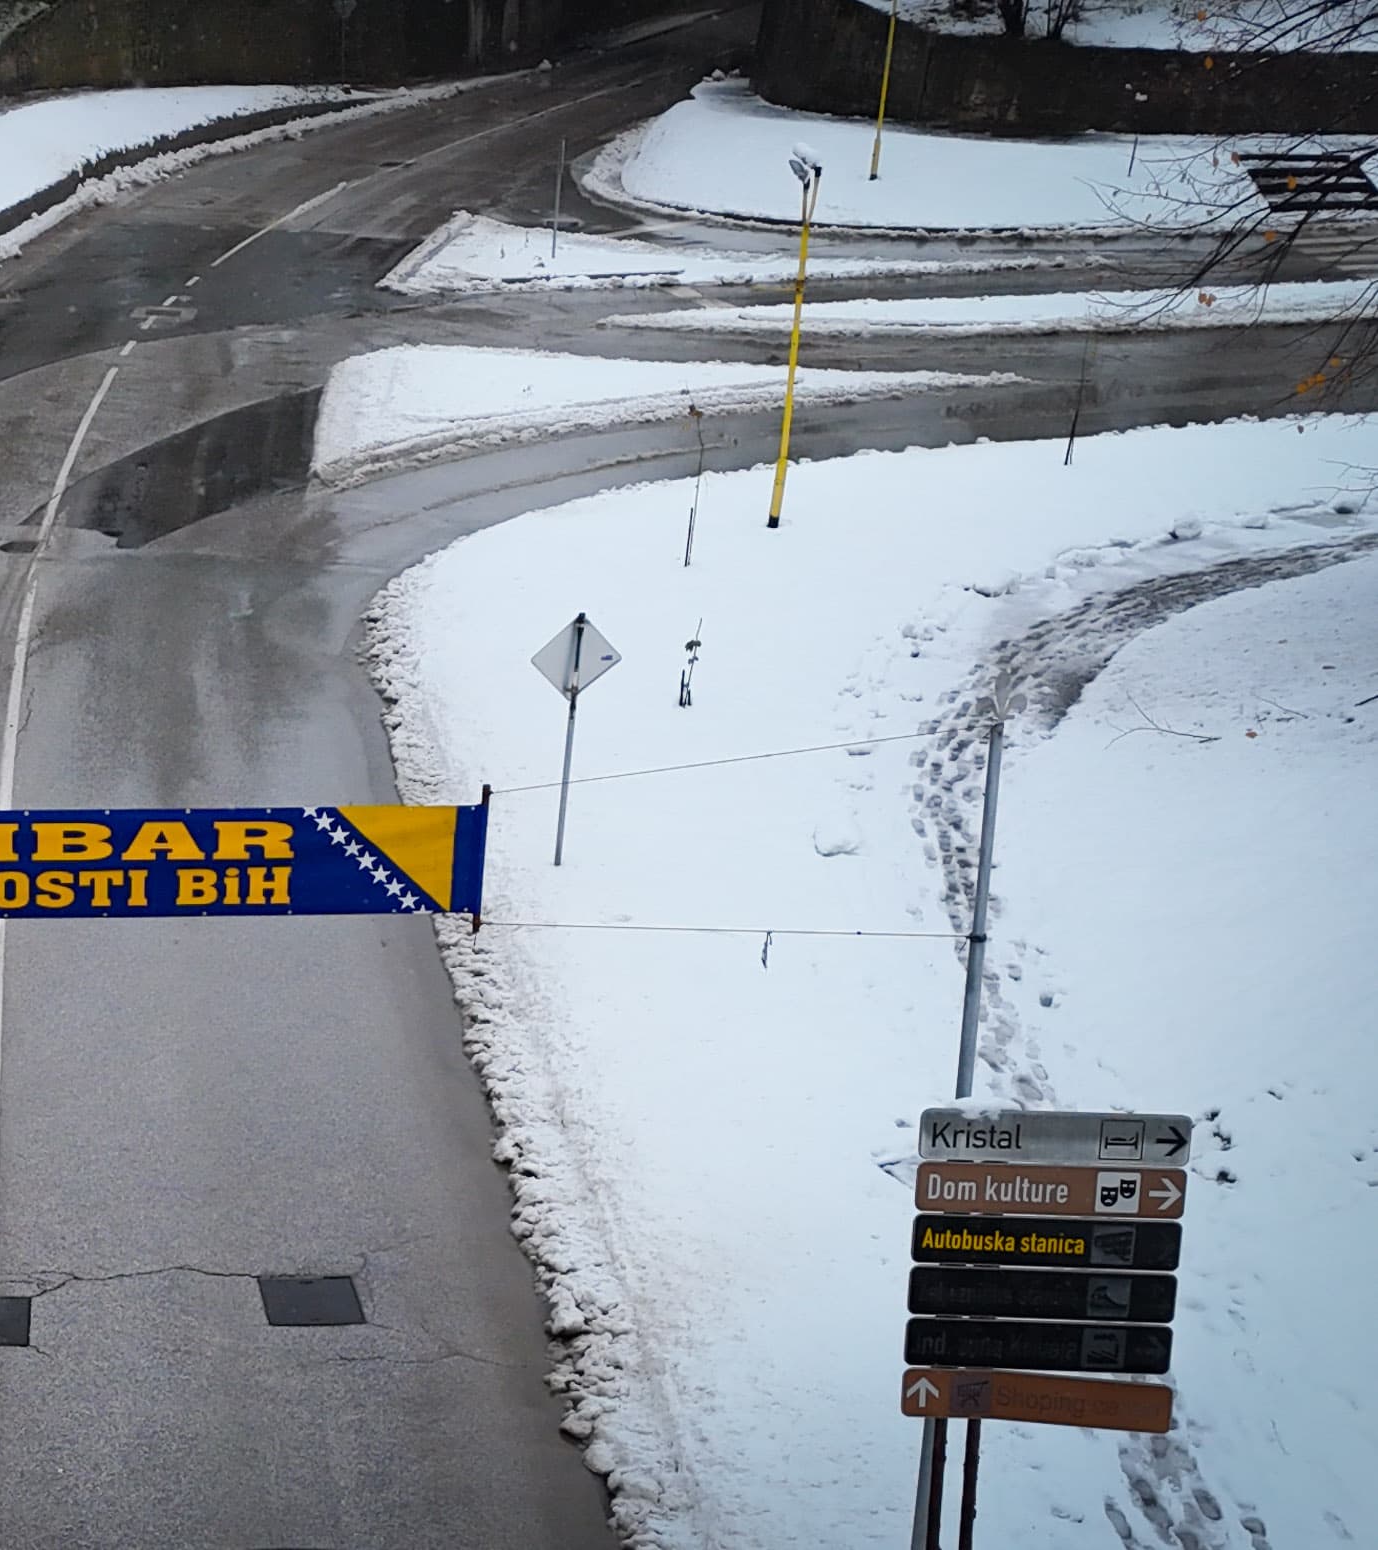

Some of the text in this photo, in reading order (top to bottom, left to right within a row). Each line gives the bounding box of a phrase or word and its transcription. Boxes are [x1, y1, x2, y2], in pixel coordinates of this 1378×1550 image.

[175, 866, 293, 906] BiH
[930, 1122, 1023, 1150] Kristal
[926, 1173, 1069, 1204] Dom kulture
[921, 1227, 1085, 1255] Autobuska stanica
